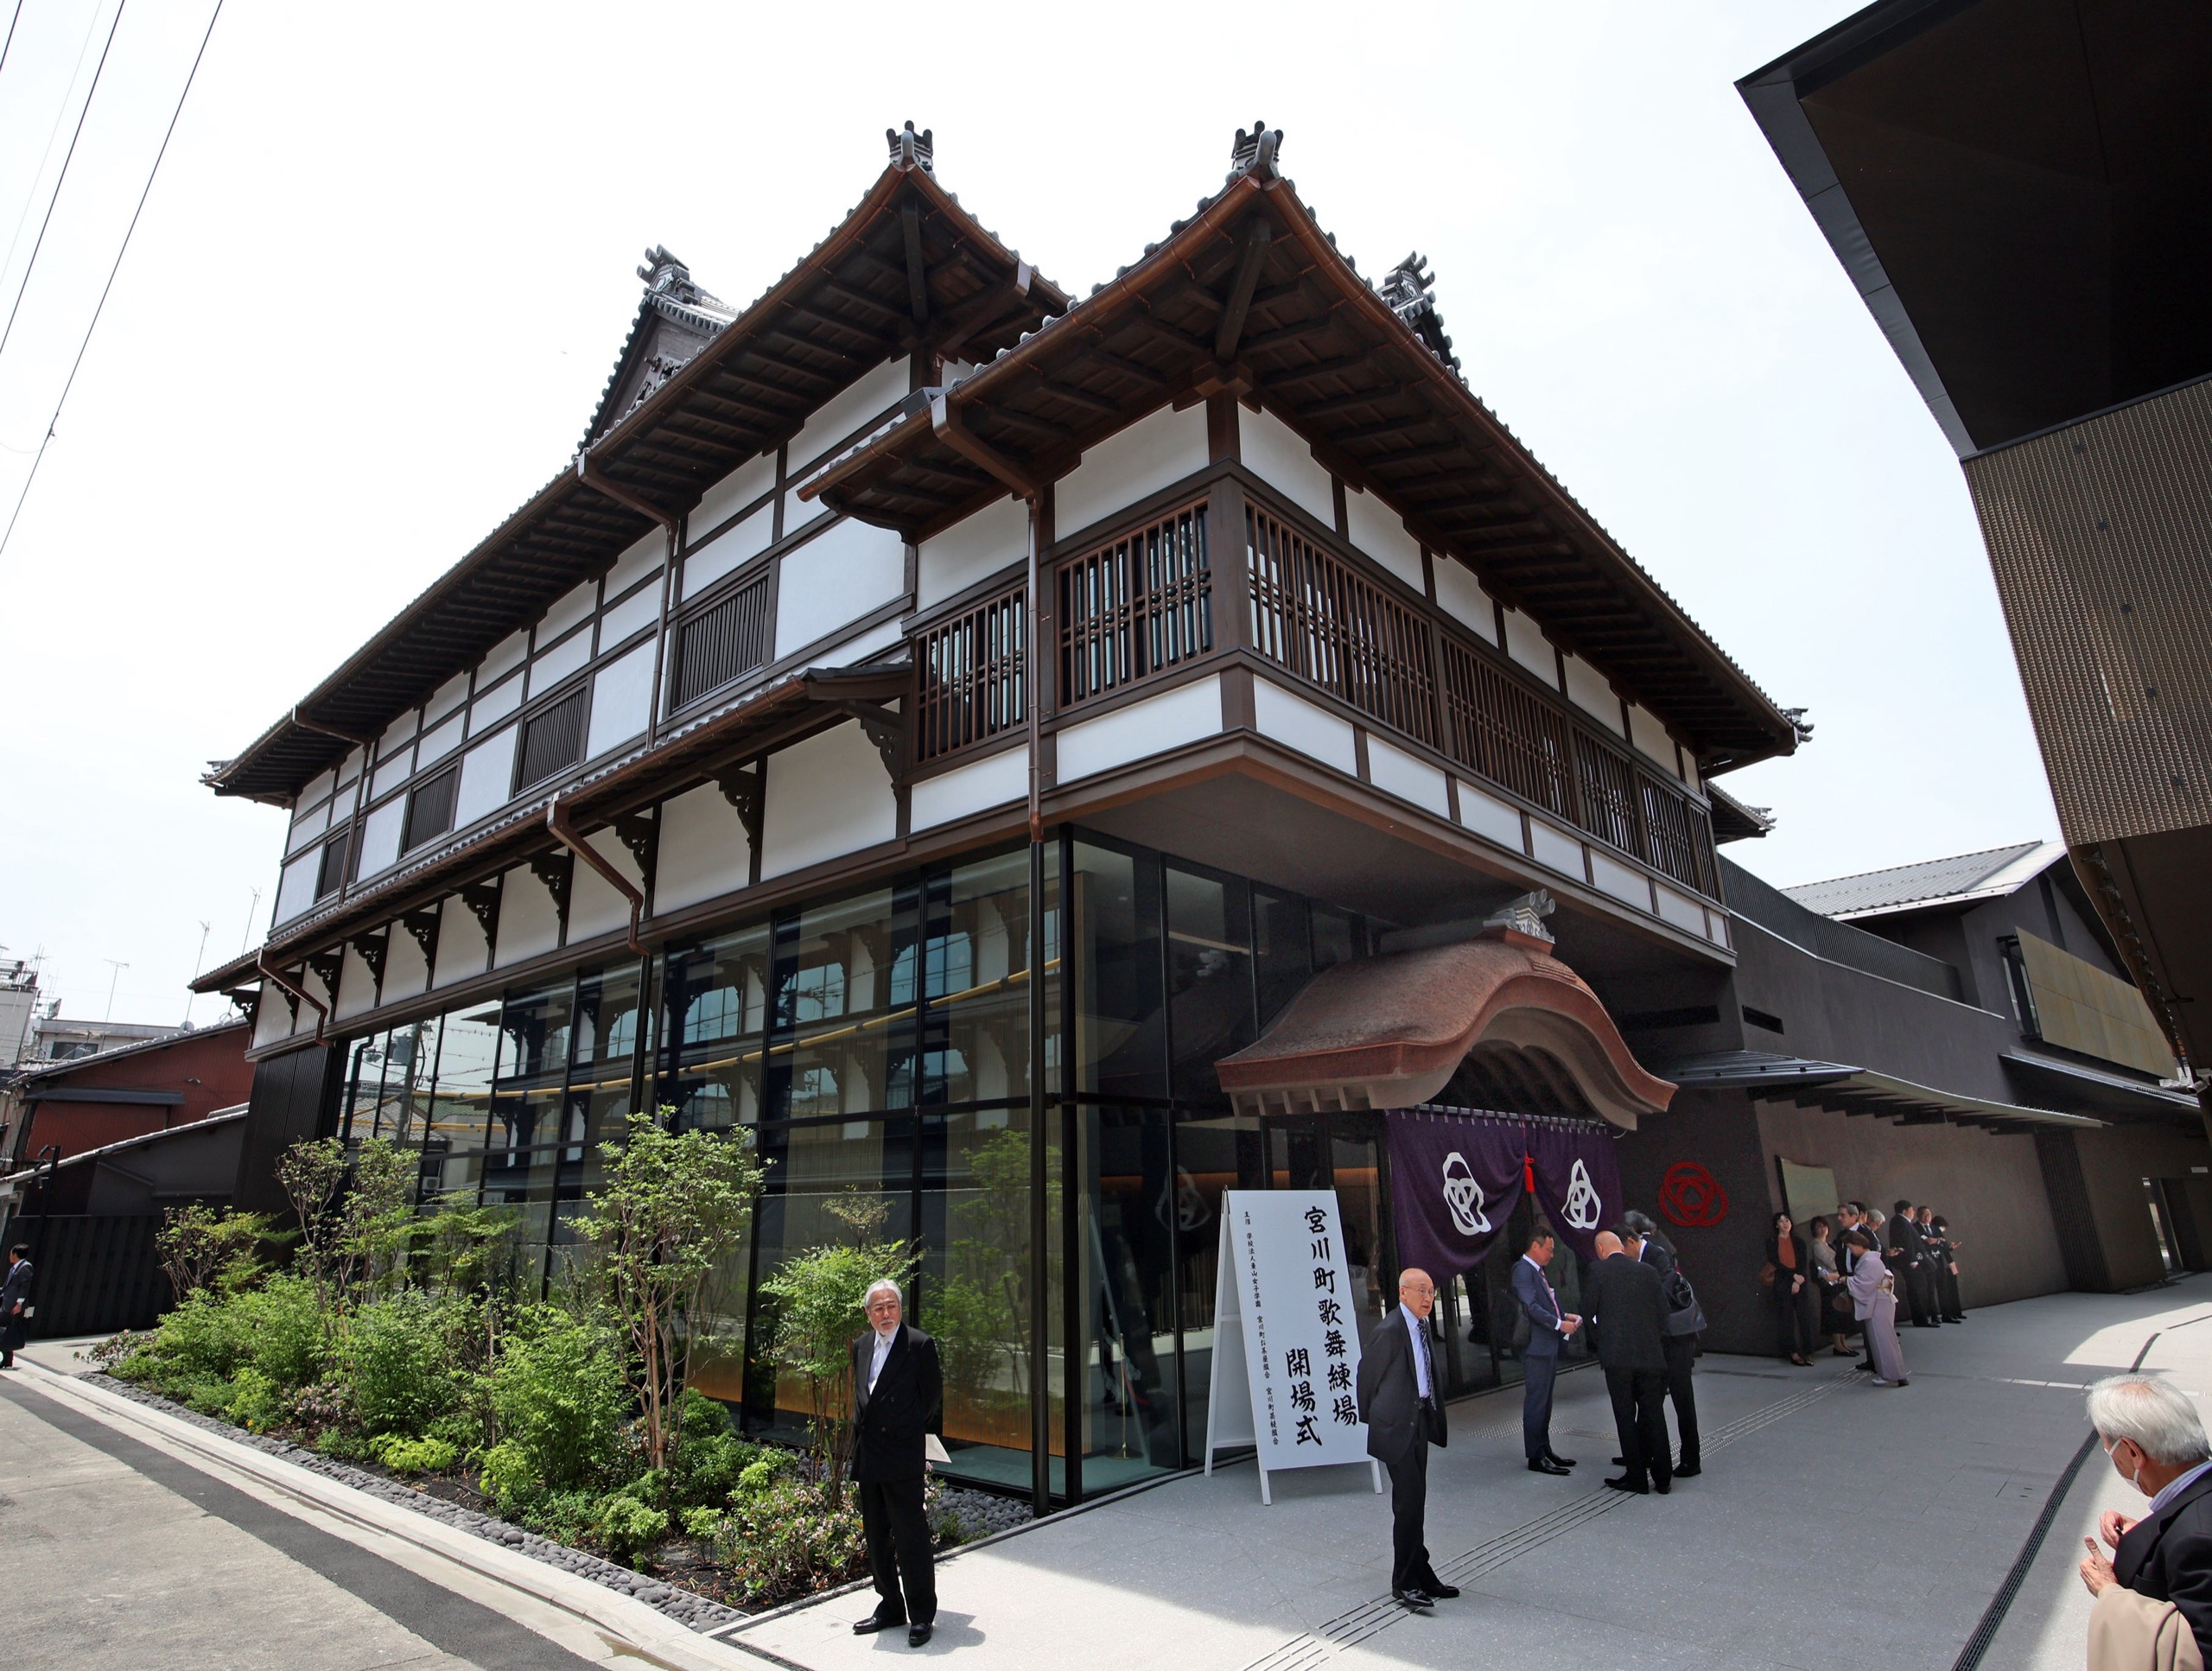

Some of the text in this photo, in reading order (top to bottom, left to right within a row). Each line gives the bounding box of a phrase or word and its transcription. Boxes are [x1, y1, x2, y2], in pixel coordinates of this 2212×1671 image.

[1304, 1206, 1357, 1426] 宮川町歌舞練場
[1286, 1348, 1322, 1446] 開場式
